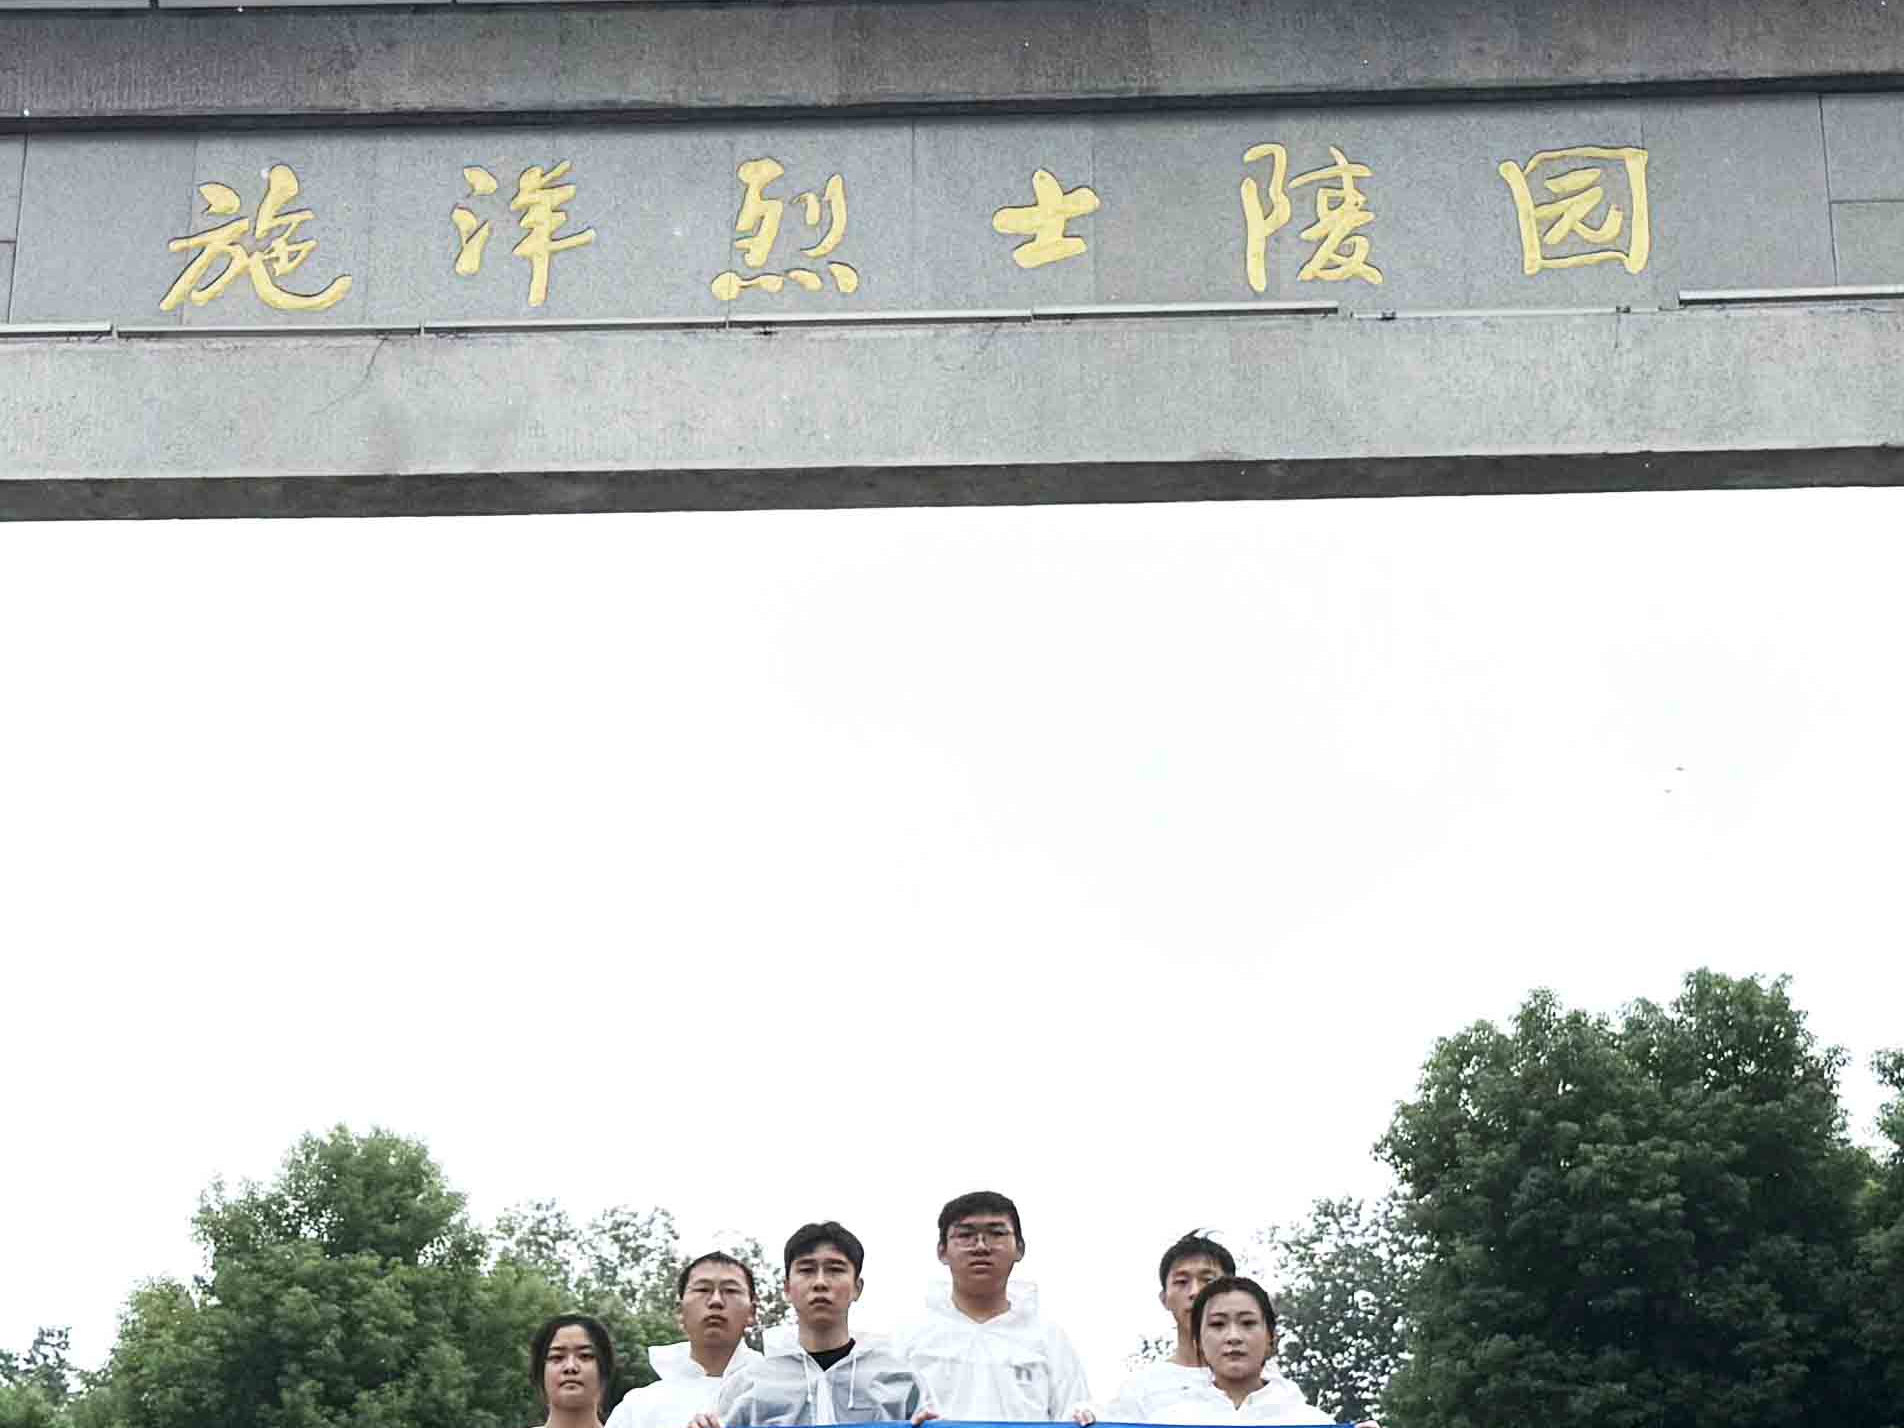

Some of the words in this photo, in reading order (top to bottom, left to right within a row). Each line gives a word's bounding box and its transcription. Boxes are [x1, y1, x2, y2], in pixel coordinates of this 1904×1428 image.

[160, 144, 1652, 310] 施洋烈士陵园
